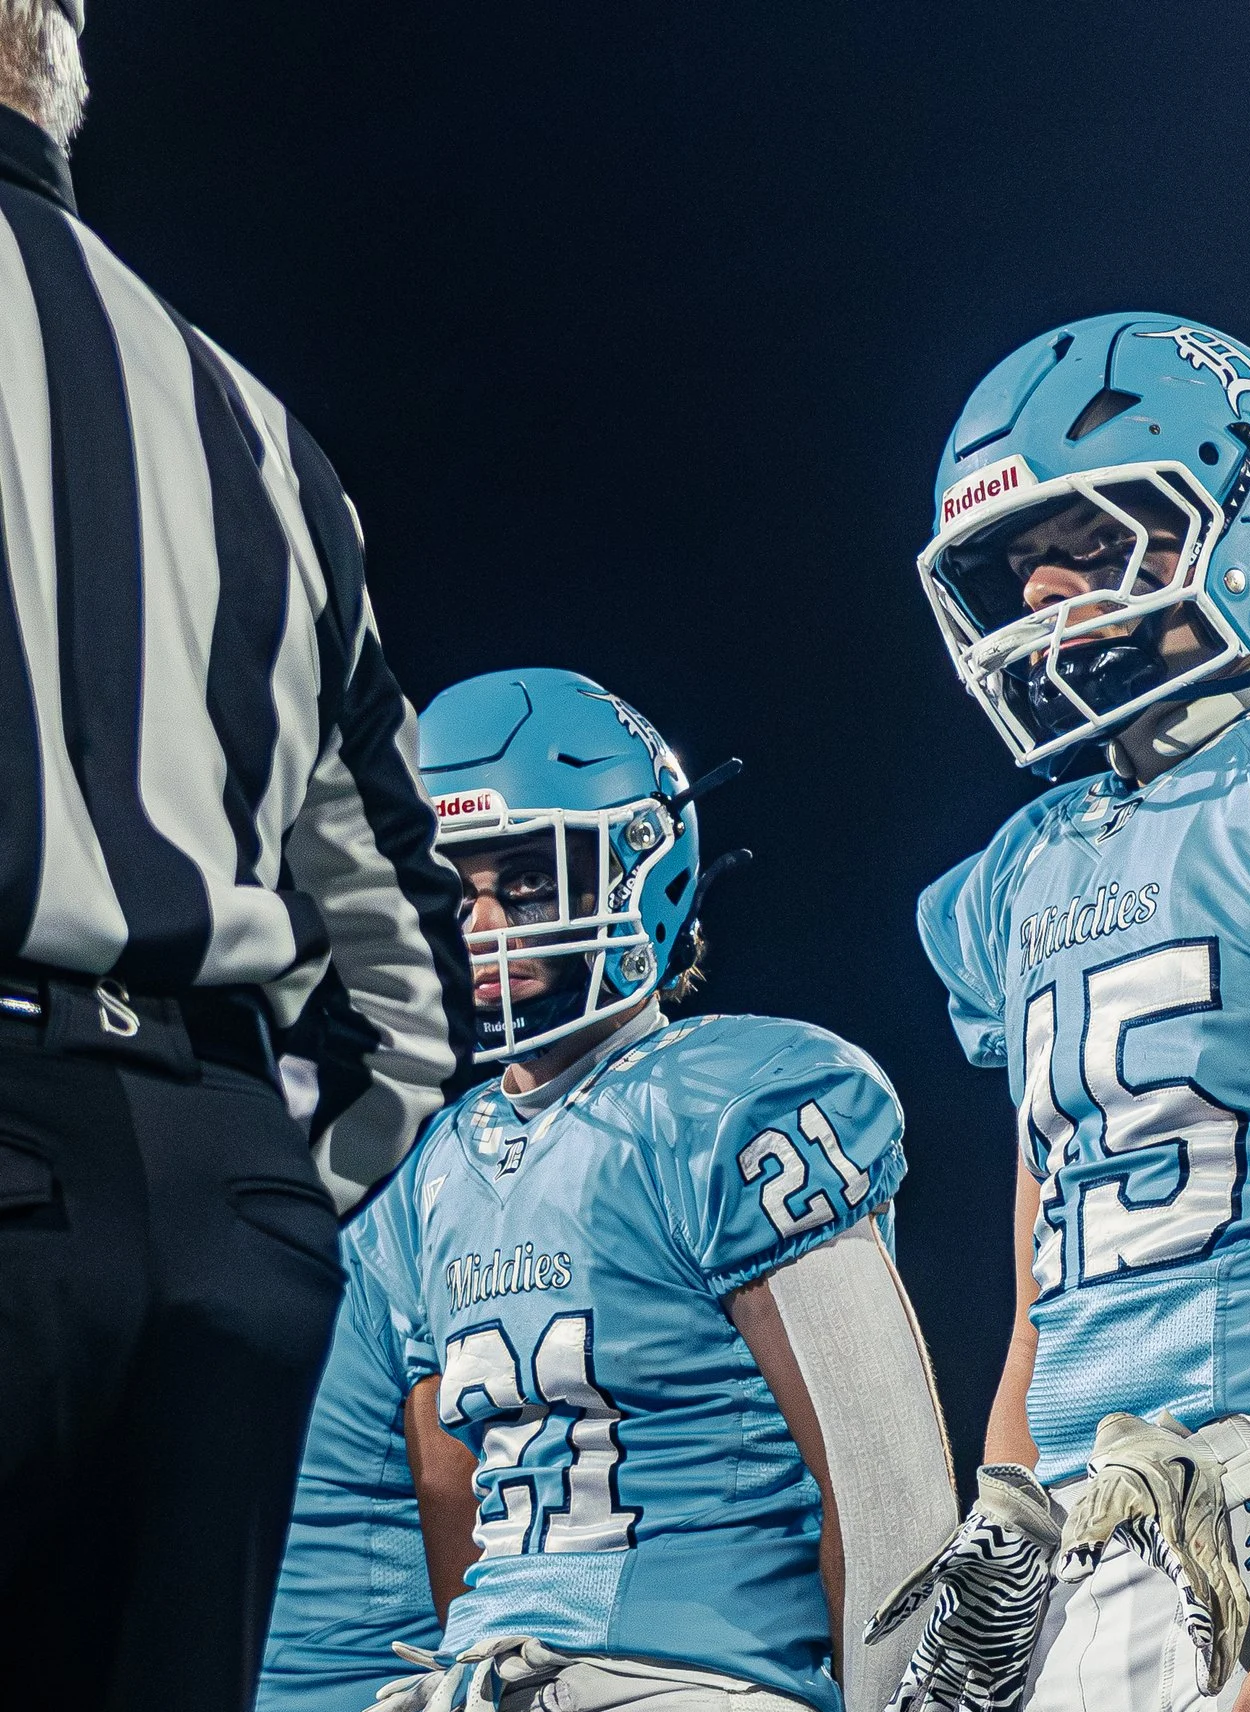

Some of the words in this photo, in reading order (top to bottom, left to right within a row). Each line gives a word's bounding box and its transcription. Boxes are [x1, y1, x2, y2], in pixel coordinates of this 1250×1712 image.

[943, 466, 1019, 524] Riddell
[435, 793, 491, 817] ddell
[1019, 880, 1161, 977] Middies
[736, 1098, 871, 1241] 21
[446, 1241, 572, 1316] Middies
[437, 1308, 644, 1562] 21
